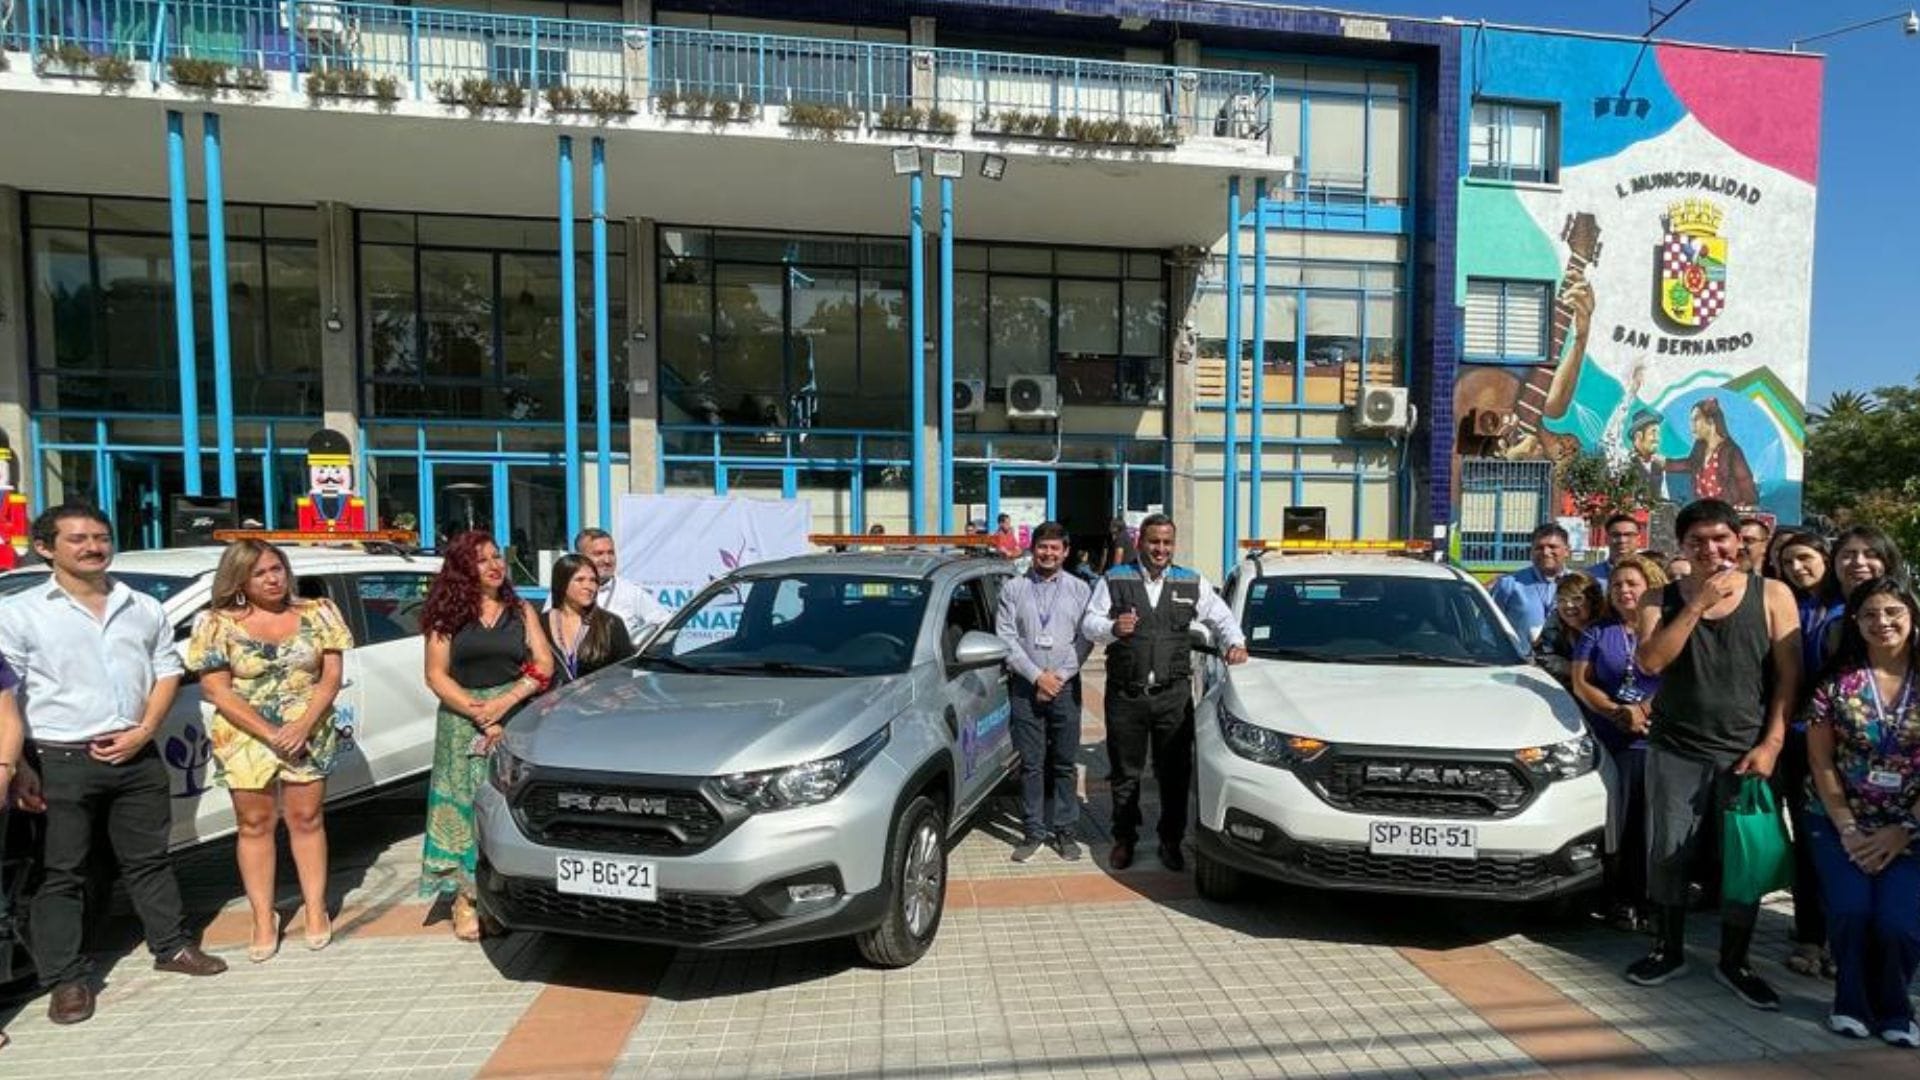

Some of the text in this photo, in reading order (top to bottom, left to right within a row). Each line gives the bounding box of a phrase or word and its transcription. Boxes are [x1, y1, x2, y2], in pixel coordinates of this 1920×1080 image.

[1630, 171, 1761, 205] MUNICIPALIDAD
[1613, 325, 1754, 356] SAN BERNARDO
[558, 792, 668, 815] RAM
